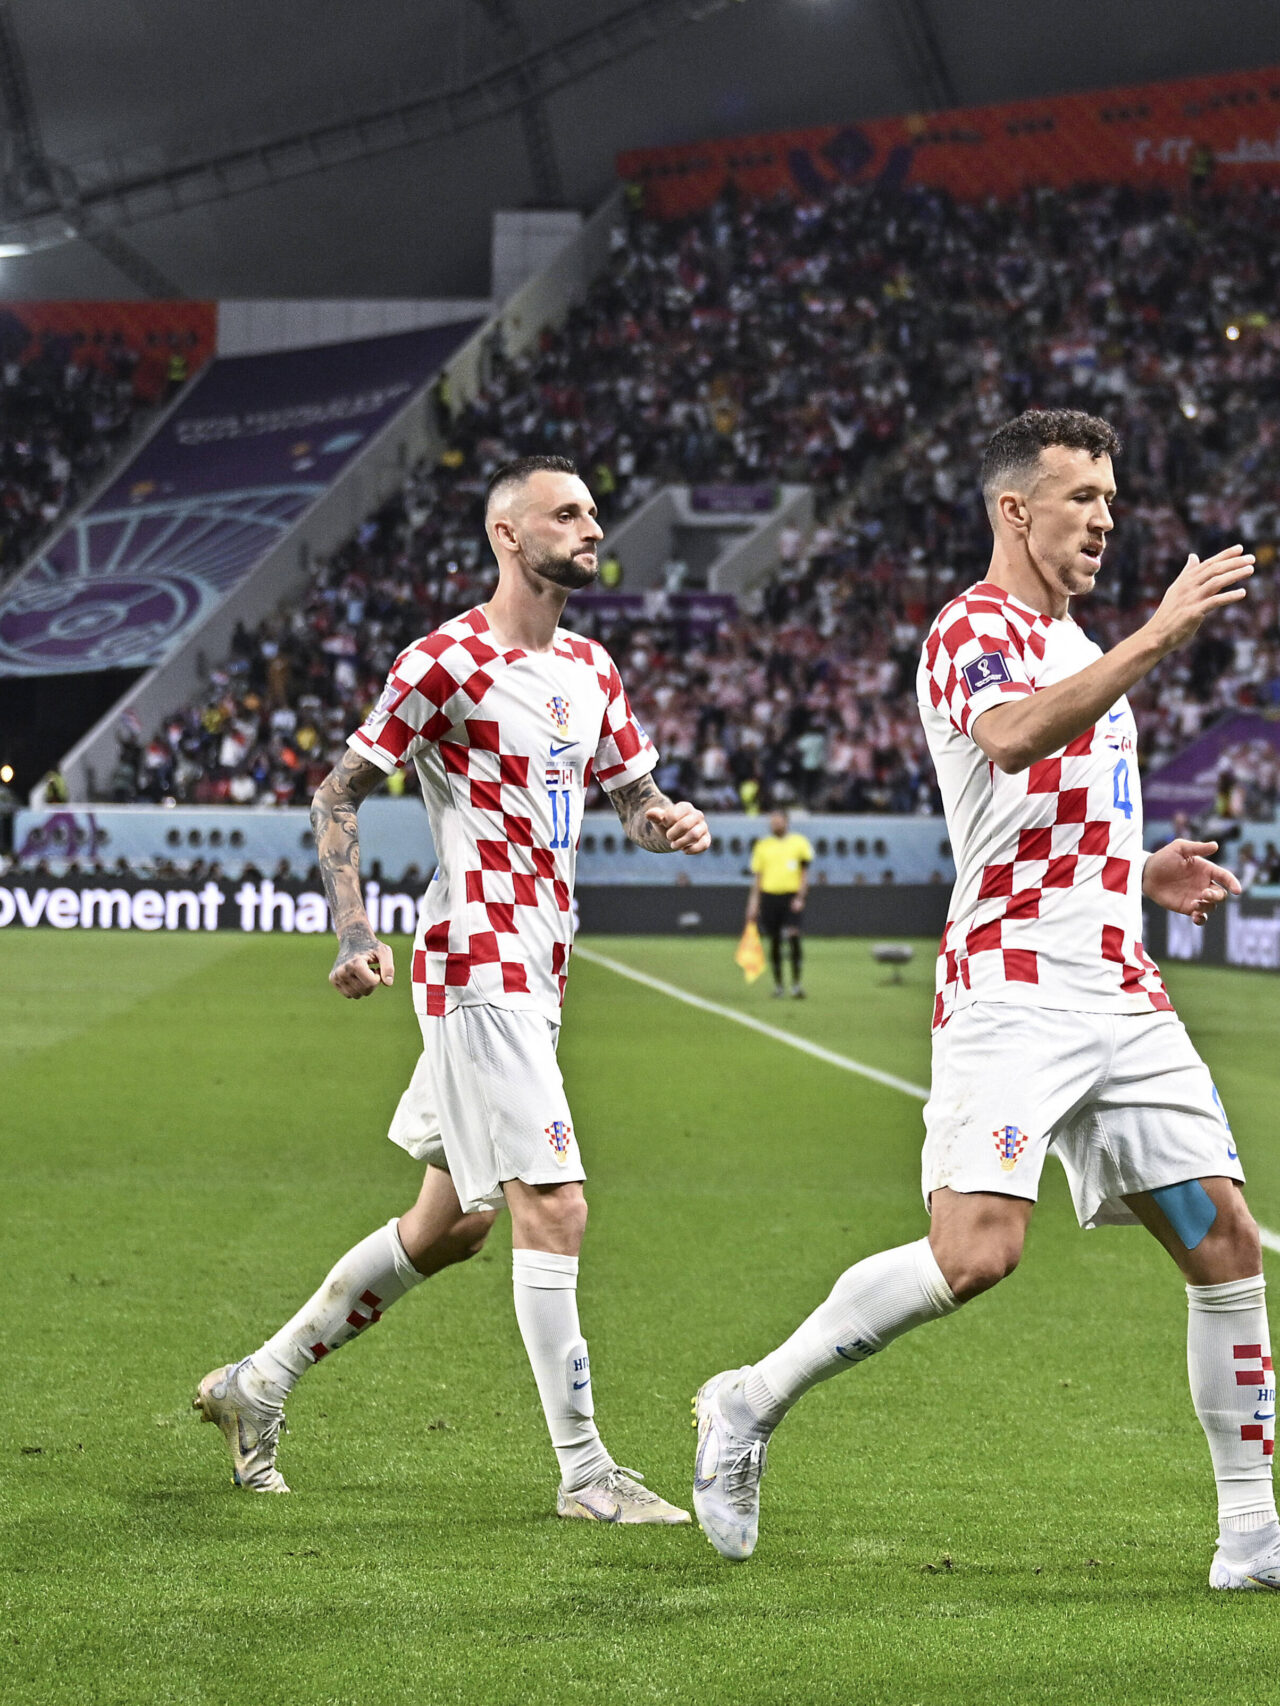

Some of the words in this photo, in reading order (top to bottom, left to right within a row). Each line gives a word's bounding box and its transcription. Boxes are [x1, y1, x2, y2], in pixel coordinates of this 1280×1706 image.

[1113, 758, 1133, 820] 4
[547, 790, 572, 849] 11
[235, 880, 336, 933] tha
